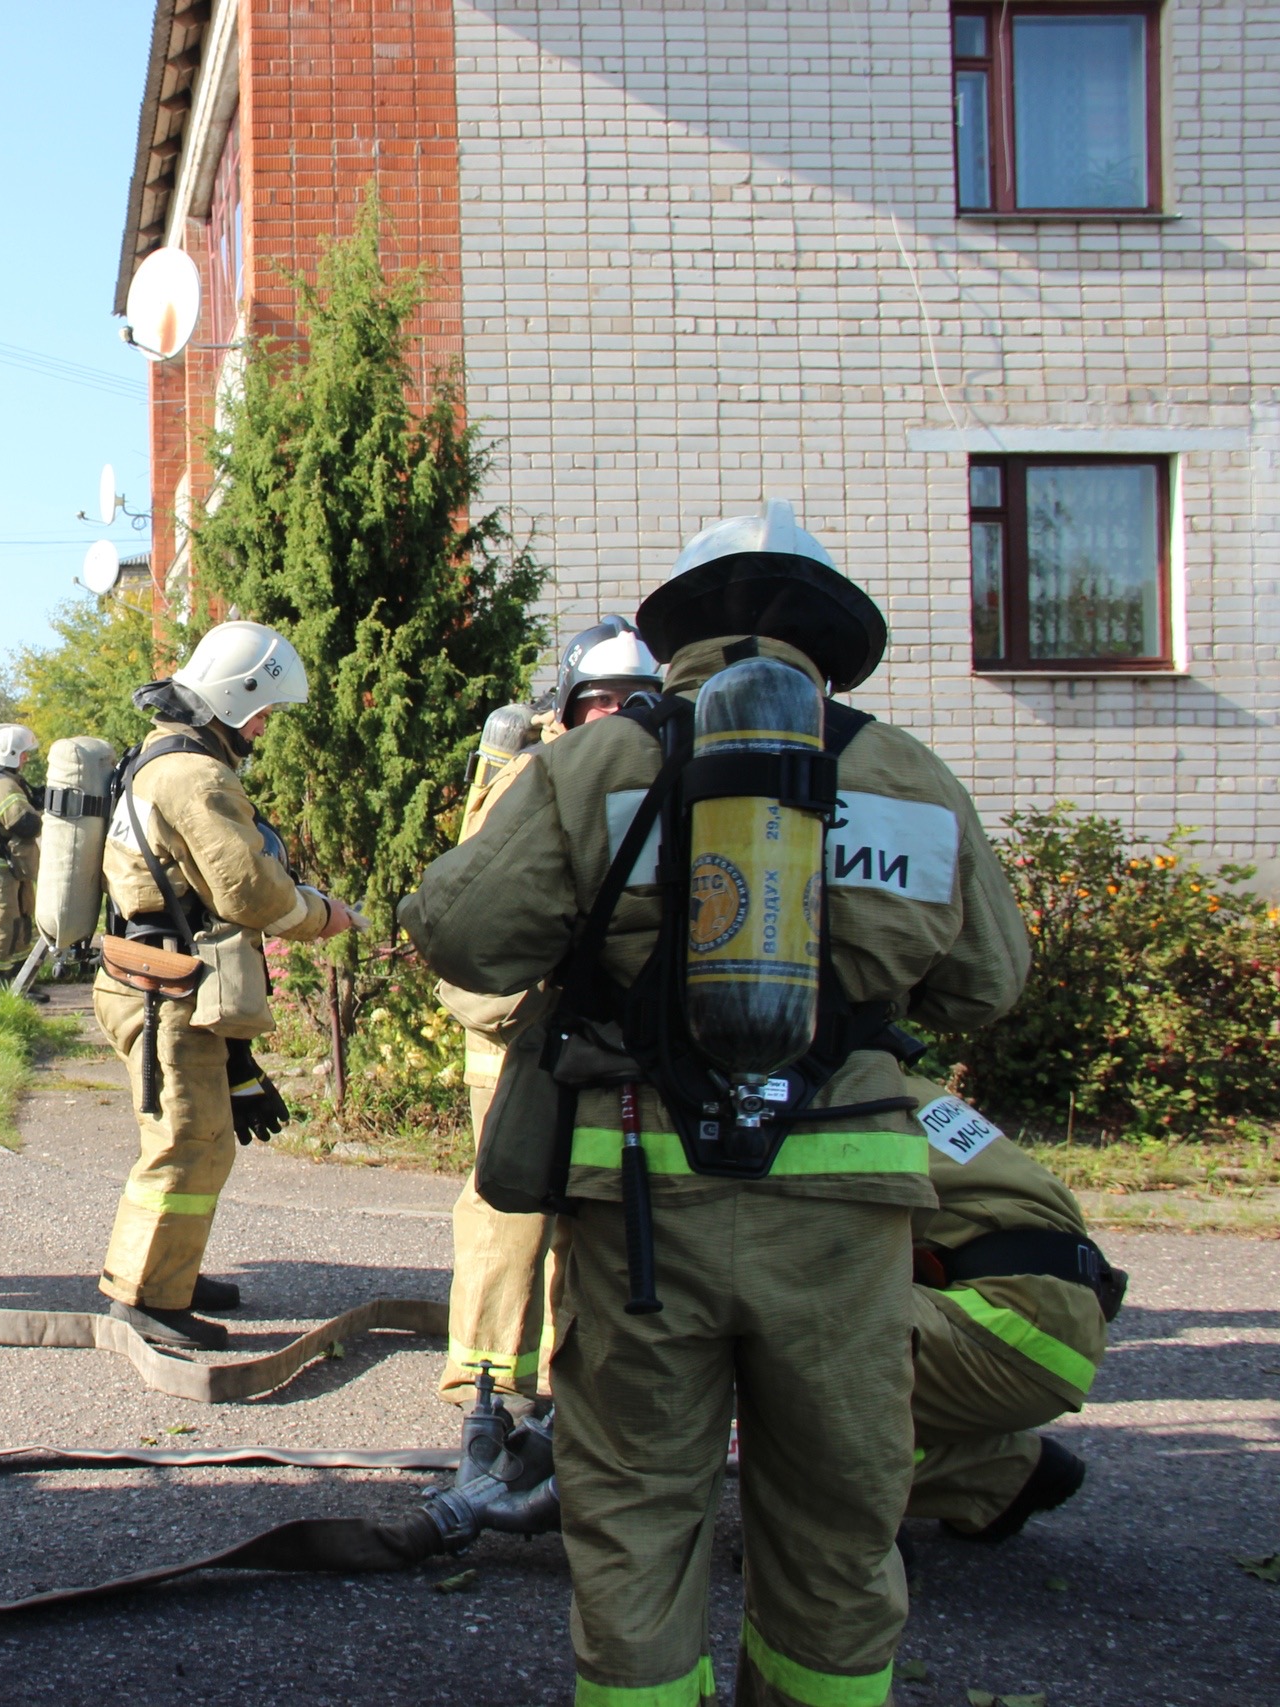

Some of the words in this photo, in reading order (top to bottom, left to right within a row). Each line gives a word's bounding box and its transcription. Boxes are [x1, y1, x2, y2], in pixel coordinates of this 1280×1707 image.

[264, 657, 283, 678] 26
[766, 805, 782, 840] 29,4
[763, 869, 780, 954] ВОЗДУХ
[948, 1119, 990, 1153] МЧС
